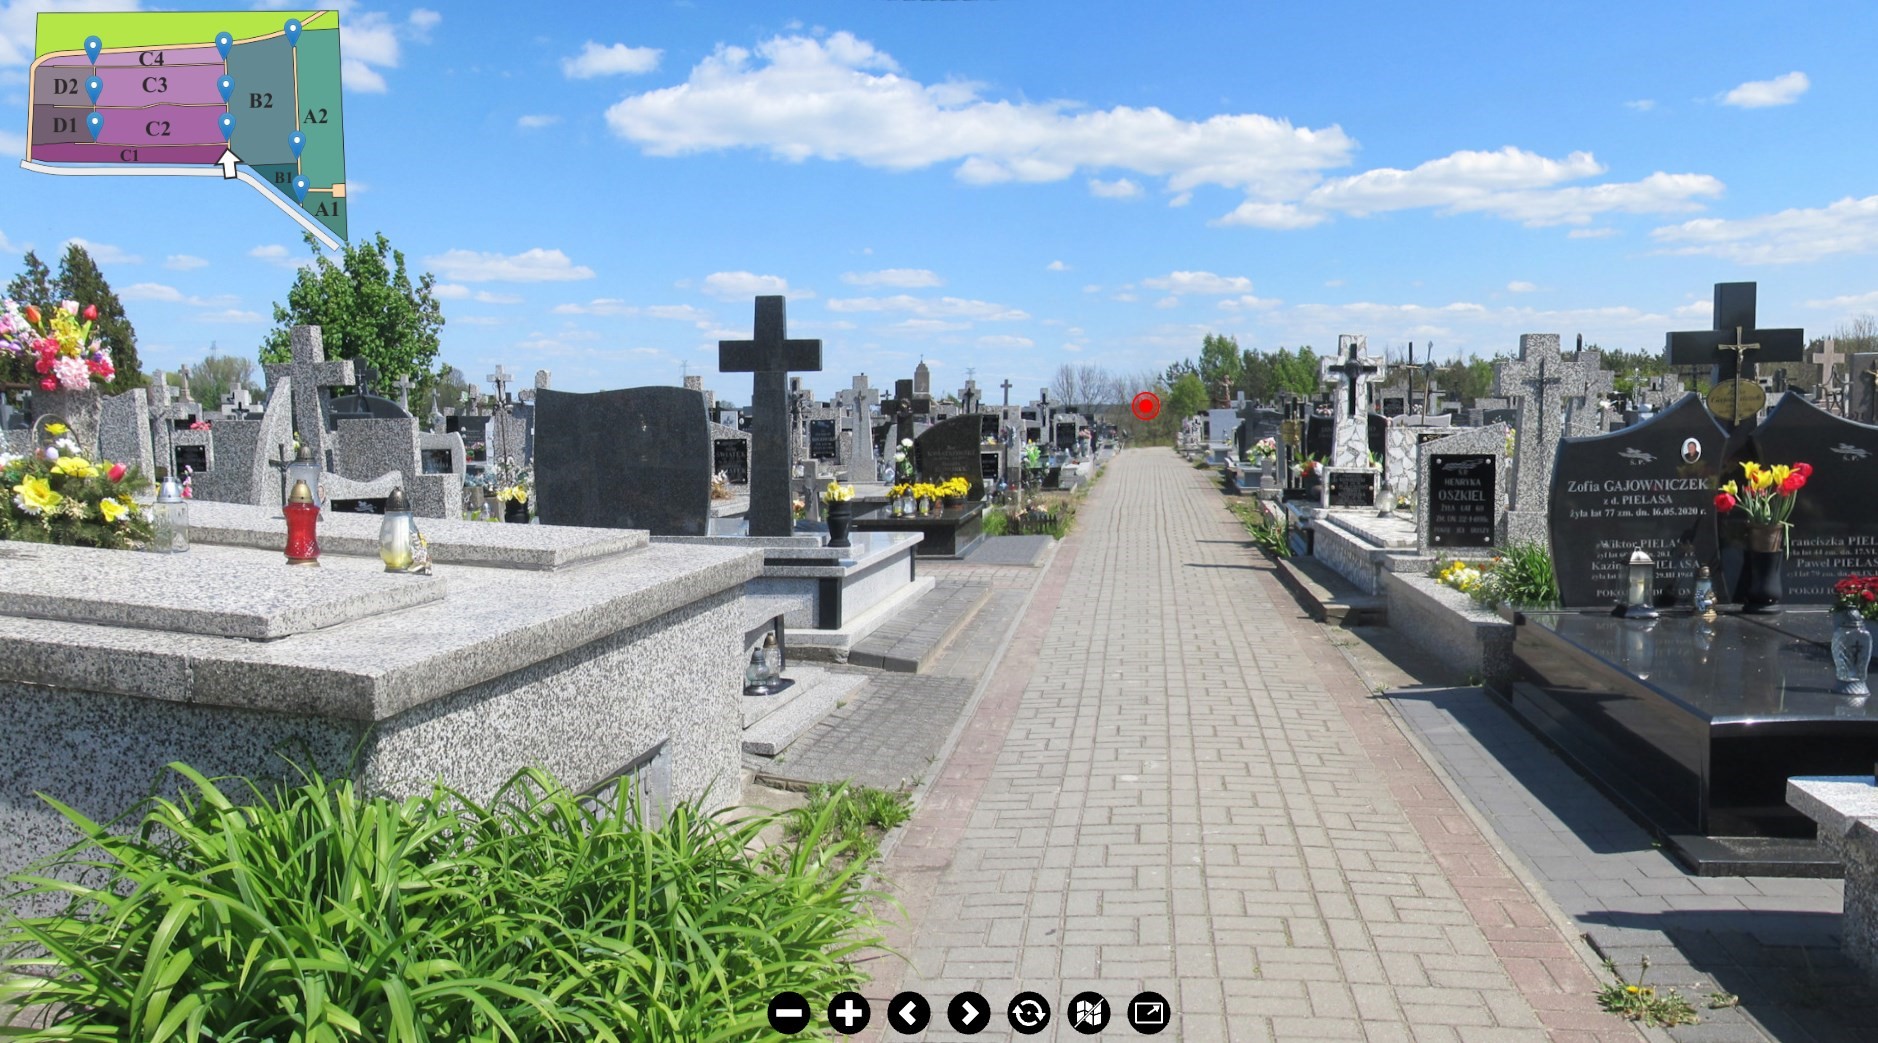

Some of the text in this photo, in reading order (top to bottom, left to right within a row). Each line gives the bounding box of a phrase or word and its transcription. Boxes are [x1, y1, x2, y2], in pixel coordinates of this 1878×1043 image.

[1444, 478, 1481, 487] HENRYKA
[1568, 478, 1709, 493] Zofia GAJOWNICZEK
[1438, 490, 1486, 501] OSZKIEL
[1611, 496, 1619, 505] d.
[1622, 494, 1673, 505] PIELASA
[1605, 508, 1615, 517] 77
[1635, 508, 1650, 517] dn.
[1653, 507, 1699, 517] 16.05.2020
[1700, 507, 1707, 516] r.
[1600, 539, 1638, 549] Wiktor
[1655, 560, 1701, 570] IELASA
